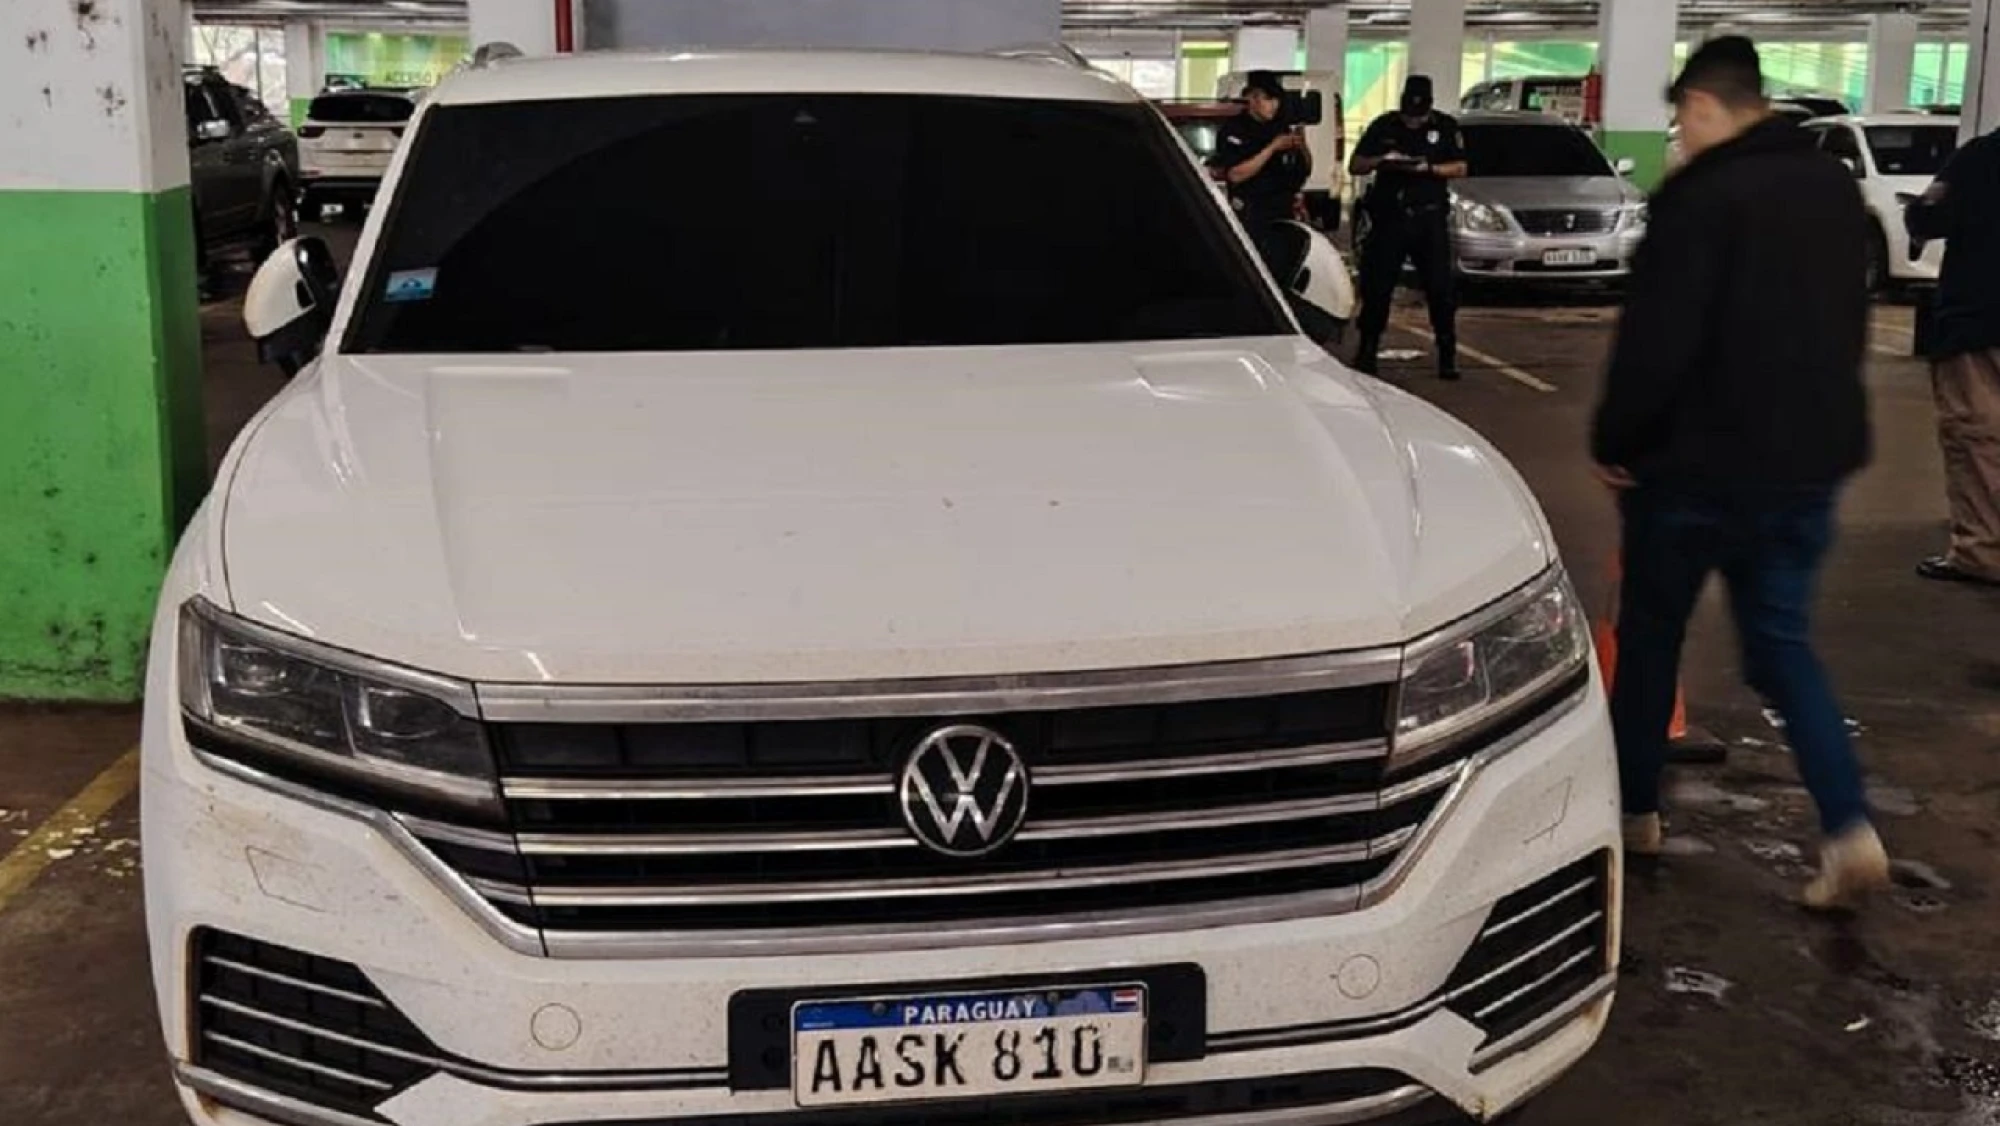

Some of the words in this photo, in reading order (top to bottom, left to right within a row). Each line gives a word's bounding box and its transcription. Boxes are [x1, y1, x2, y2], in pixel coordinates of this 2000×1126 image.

[904, 730, 1025, 850] VW
[904, 999, 1036, 1024] PARAGUAY
[811, 1033, 966, 1093] AASK
[993, 1023, 1103, 1081] 810
